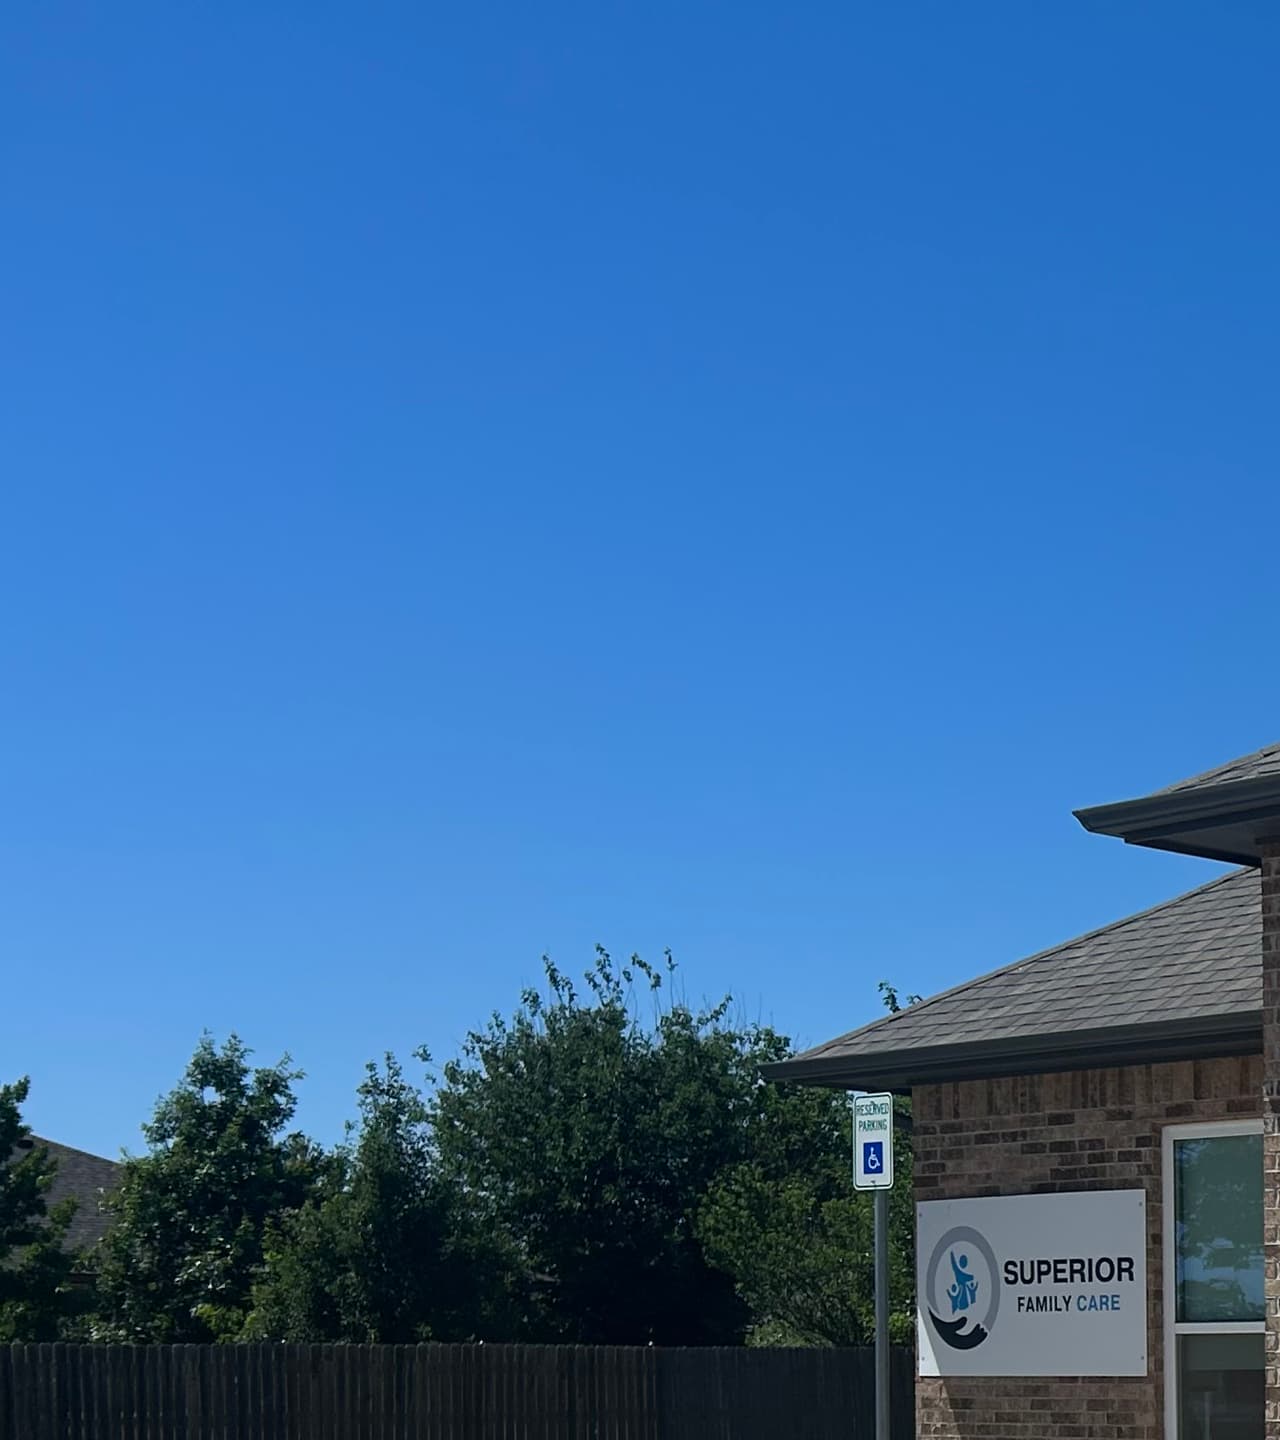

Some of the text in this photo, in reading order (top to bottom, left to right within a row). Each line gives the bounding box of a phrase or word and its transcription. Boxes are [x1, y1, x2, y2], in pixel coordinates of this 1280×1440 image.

[856, 1102, 889, 1116] RESERVED
[858, 1119, 888, 1131] PARKING
[1004, 1257, 1135, 1285] SUPERIOR
[1017, 1294, 1121, 1313] FAMILY CARE
